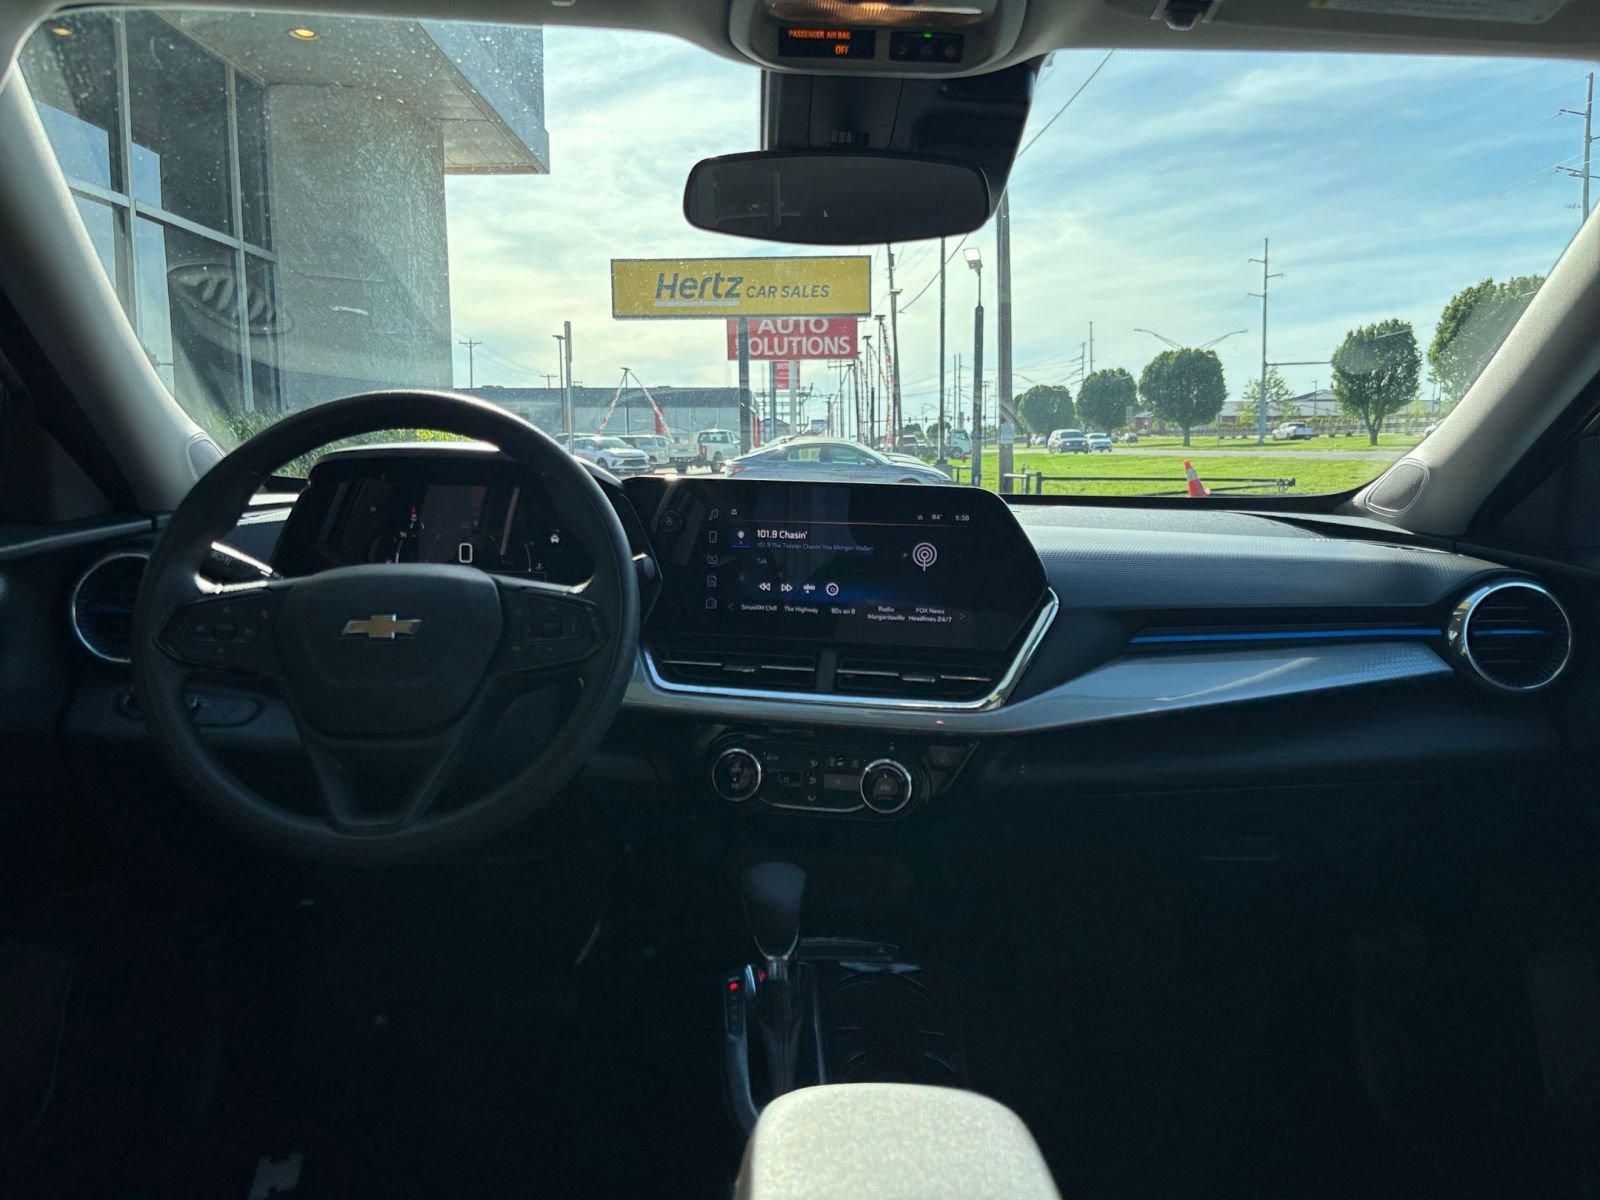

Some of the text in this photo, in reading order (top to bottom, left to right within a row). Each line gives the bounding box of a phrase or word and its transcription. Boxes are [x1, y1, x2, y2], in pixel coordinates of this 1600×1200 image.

[788, 29, 825, 39] PASSENGER
[834, 45, 850, 55] OFF
[655, 271, 830, 299] Hertz CAR SALES
[757, 318, 829, 334] AUTO
[735, 336, 851, 356] OLUTIONS
[756, 529, 808, 540] 101.9 Chasin'
[833, 544, 854, 553] Morgan
[784, 605, 819, 615] The Highway
[878, 605, 895, 613] Radio
[867, 613, 906, 621] Margaritaville
[909, 615, 953, 624] Headlines 24/7
